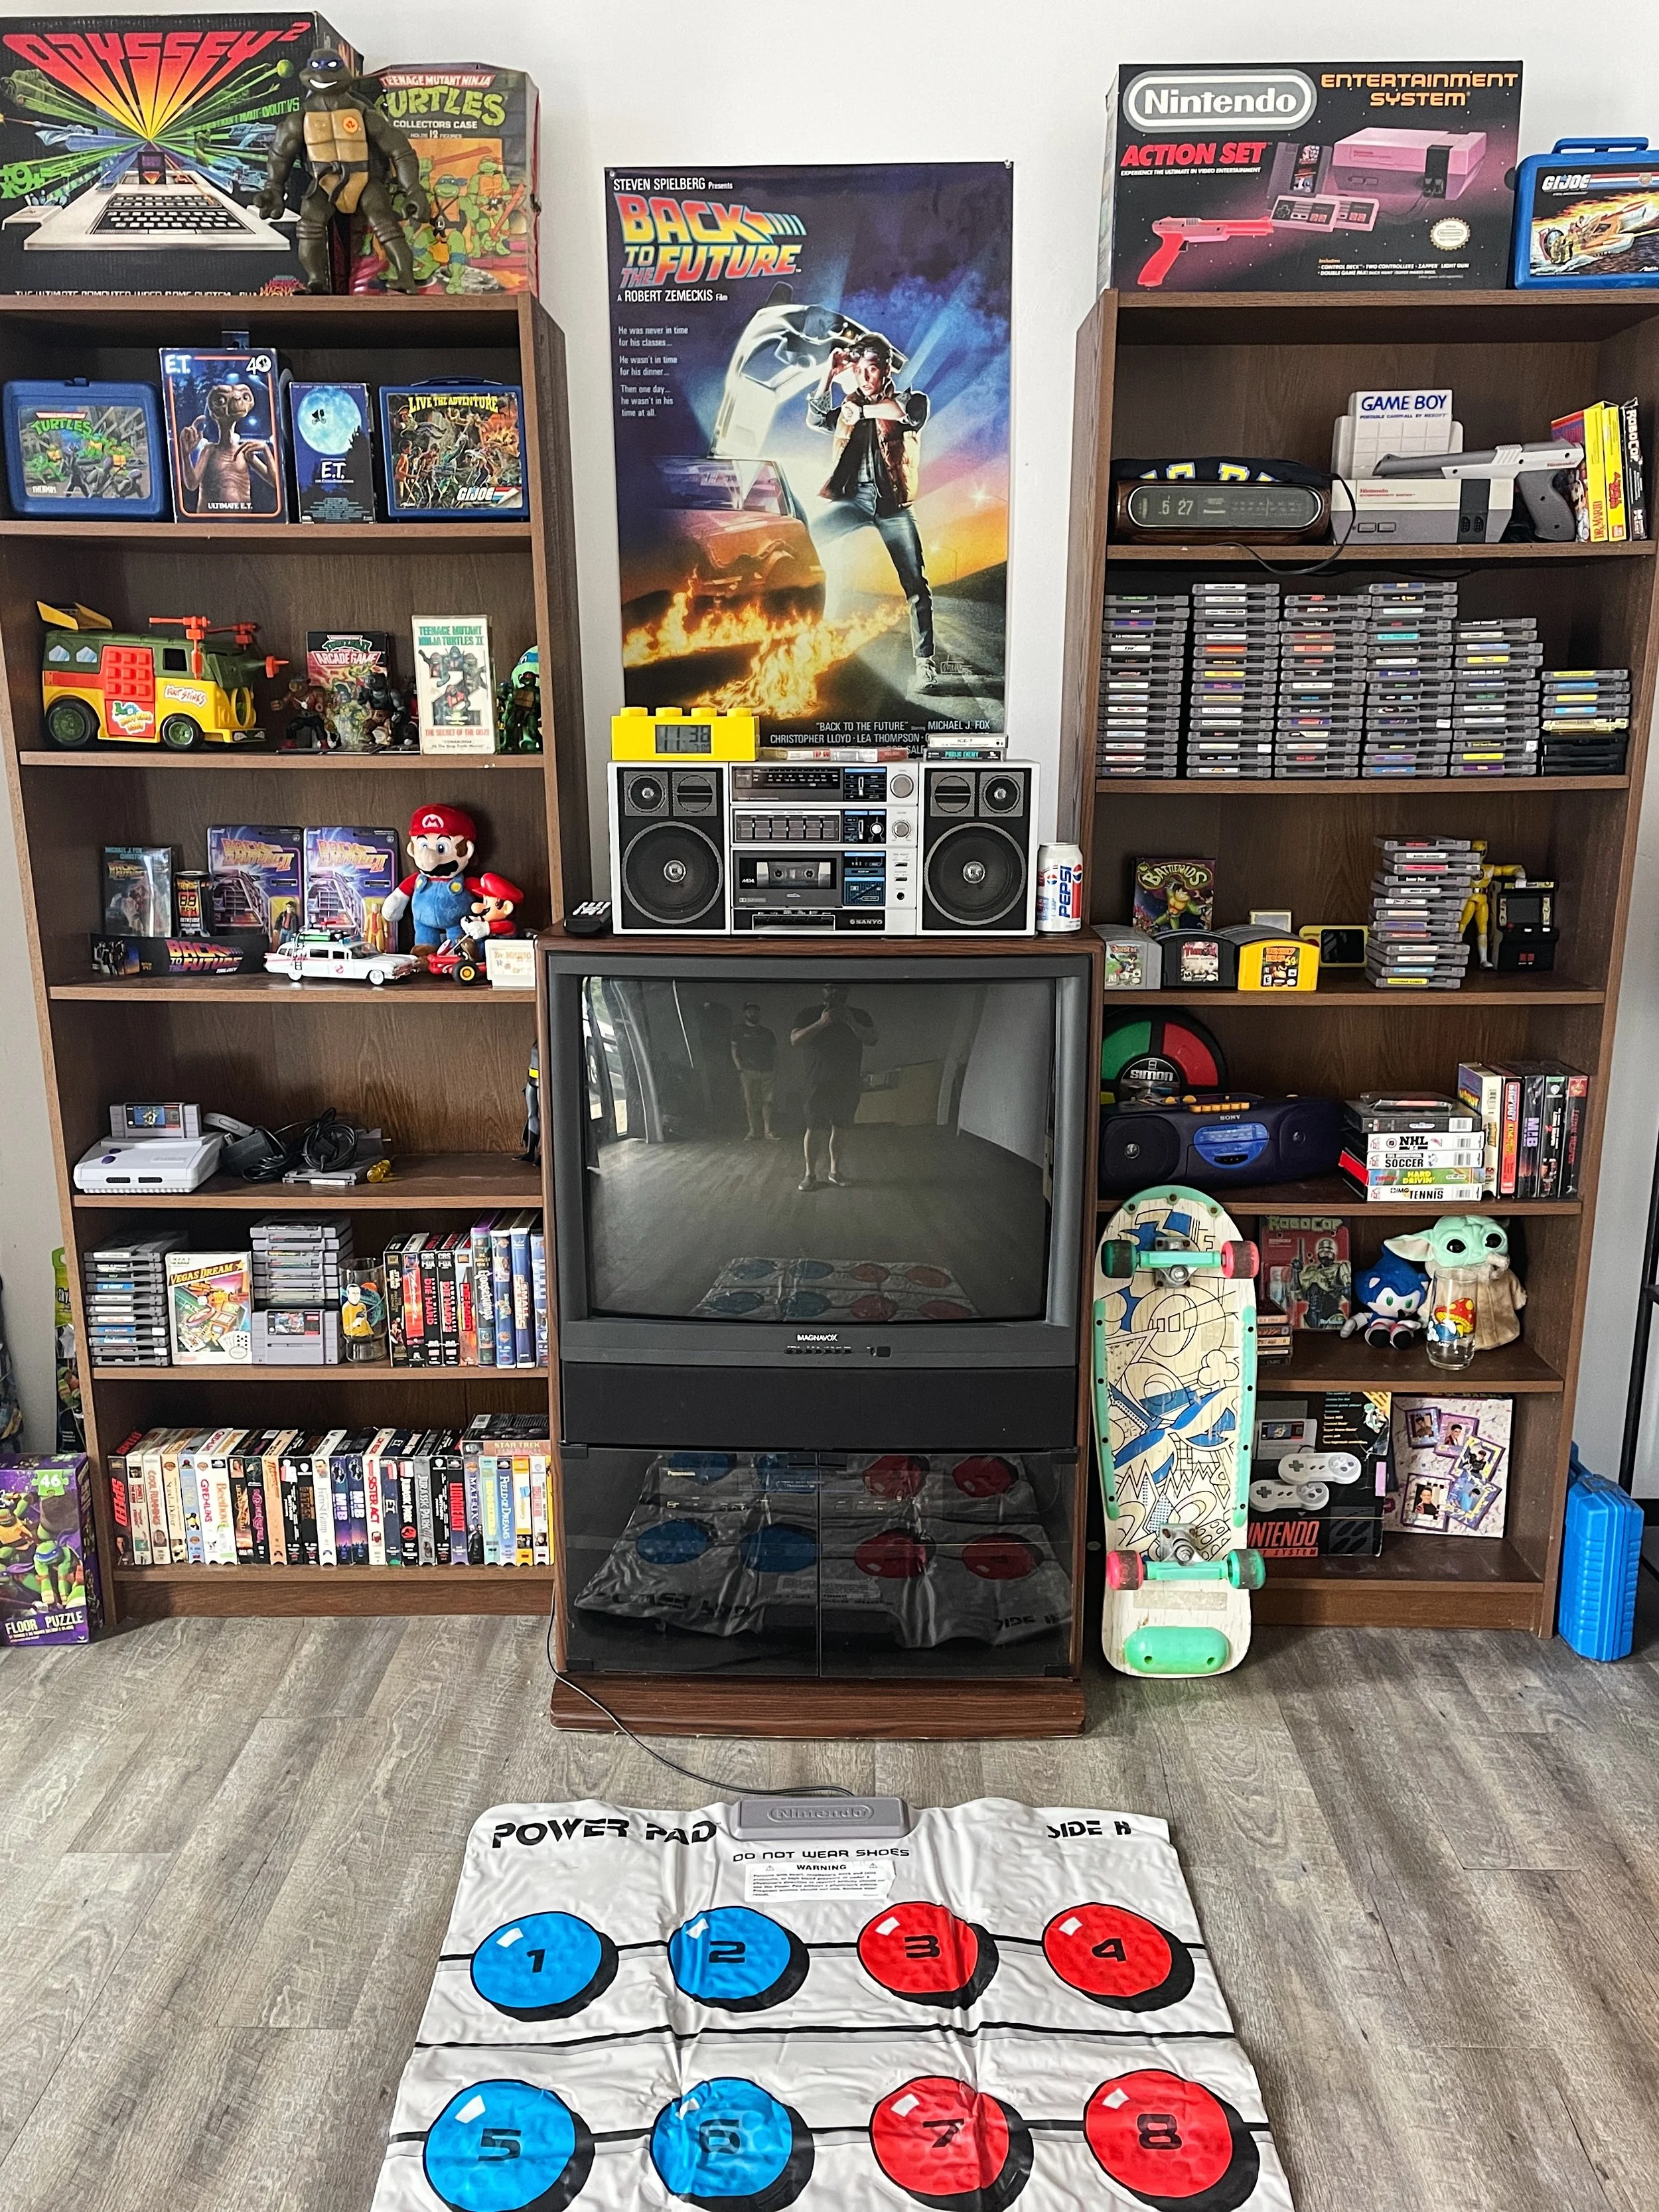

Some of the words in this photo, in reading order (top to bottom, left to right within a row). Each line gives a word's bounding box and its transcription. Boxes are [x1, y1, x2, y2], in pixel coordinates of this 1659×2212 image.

[380, 75, 424, 86] TEENAGE
[425, 74, 461, 86] MUTANT
[462, 74, 493, 86] NINJA
[1321, 73, 1518, 88] ENTERTAINMENT
[1144, 87, 1297, 114] Nintendo
[1370, 92, 1466, 106] SYSTEM
[429, 130, 439, 139] 12
[1119, 142, 1217, 167] ACTION
[1219, 142, 1267, 165] SET
[614, 178, 650, 190] STEVEN
[654, 178, 705, 190] SPIELBERG
[614, 192, 774, 244] BACK
[625, 245, 656, 268] TO
[653, 244, 803, 287] FUTURE
[620, 267, 656, 289] THE
[624, 291, 662, 302] ROBERT
[665, 289, 713, 301] ZEMECKIS
[630, 338, 640, 346] his
[165, 354, 192, 374] E.T.
[619, 355, 628, 364] He
[630, 355, 653, 364] wasn't
[631, 367, 641, 376] his
[408, 396, 432, 413] LIVE
[432, 396, 447, 406] THE
[448, 396, 498, 413] ADVENTURE
[1360, 396, 1409, 411] GAME
[1414, 394, 1447, 409] BOY
[31, 419, 93, 439] TURTLES
[1626, 409, 1640, 463] ROBOCOP
[321, 461, 347, 480] E.T.
[32, 485, 57, 494] THERMOS
[419, 626, 451, 636] TEENAGE
[452, 626, 482, 636] MUTANT
[419, 636, 442, 646] NINJA
[443, 636, 474, 646] TURTLES
[315, 653, 350, 665] ARCADE
[350, 653, 380, 665] GAME
[816, 721, 841, 731] "BACK
[843, 722, 853, 731] TO
[857, 722, 871, 730] THE
[874, 721, 908, 730] FUTURE"
[928, 721, 964, 730] MICHAEL
[965, 721, 973, 730] J.
[975, 720, 991, 730] FOX
[770, 734, 825, 744] CHRISTOPHER
[827, 734, 851, 744] LLOYD
[857, 733, 871, 743] LEA
[874, 732, 920, 743] THOMPSON
[1142, 863, 1208, 886] BATTLETOADS
[180, 896, 196, 906] 88
[1058, 865, 1072, 918] PEPSI
[165, 939, 226, 957] BACK
[181, 957, 243, 972] FUTURE
[1285, 956, 1299, 966] 64
[1399, 1136, 1428, 1146] NHL
[1385, 1158, 1424, 1168] SOCCER
[1409, 1190, 1443, 1200] TENNIS
[1269, 1215, 1344, 1231] ROBOCOP
[171, 1271, 200, 1284] VEGAS
[200, 1263, 234, 1279] DREAM
[423, 1278, 433, 1294] DIE
[443, 1281, 451, 1297] DIE
[461, 1284, 470, 1300] DIE
[474, 1269, 494, 1321] Goosebumps
[425, 1297, 434, 1326] HARD
[443, 1298, 453, 1325] HARD
[463, 1300, 472, 1331] HARD
[40, 1473, 62, 1488] 46
[147, 1470, 157, 1490] COOL
[499, 1475, 510, 1499] FIELD
[200, 1479, 213, 1523] GREMLINS
[368, 1476, 379, 1506] SISTER
[399, 1477, 411, 1505] JURASSIC
[418, 1474, 430, 1508] JURASSIC
[469, 1477, 479, 1520] MATRIX
[111, 1477, 128, 1527] SPEED
[449, 1482, 465, 1533] LIONHEART
[502, 1499, 508, 1508] OF
[319, 1513, 328, 1533] Gump
[370, 1506, 380, 1524] ACT
[401, 1505, 413, 1523] PARK
[419, 1507, 431, 1530] PARK
[502, 1507, 512, 1540] DREAMS
[1273, 1548, 1317, 1556] SYSTEM
[5, 1618, 38, 1635] FLOOR
[44, 1611, 84, 1628] PUZZLE
[776, 1806, 864, 1819] Nintendo
[492, 1818, 630, 1848] POWER
[645, 1819, 717, 1846] PAD
[1046, 1820, 1103, 1839] SIDE
[733, 1852, 756, 1862] DO
[762, 1850, 796, 1860] NOT
[802, 1849, 849, 1858] WEAR
[855, 1848, 910, 1857] SHOES
[708, 1939, 746, 1964] 2
[904, 1935, 940, 1959] 3
[1092, 1937, 1127, 1963] 4
[526, 1948, 547, 1972] 1
[699, 2120, 740, 2154] 6
[924, 2118, 965, 2149] 7
[1135, 2113, 1181, 2149] 8
[476, 2128, 521, 2162] 5
